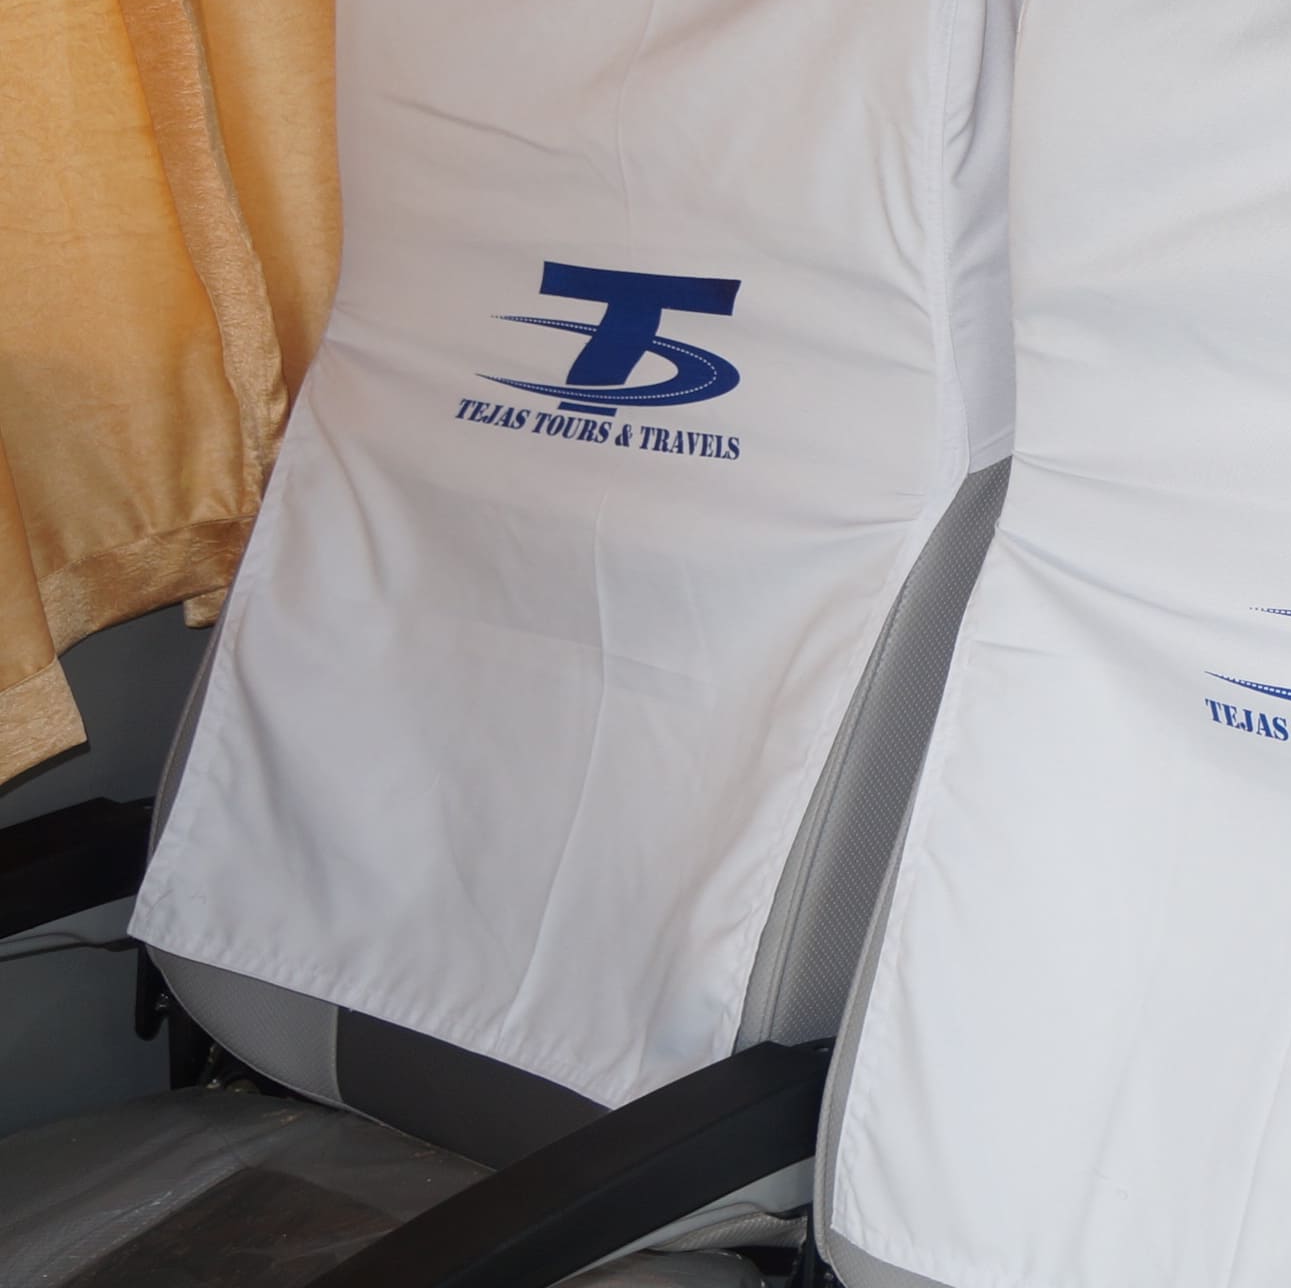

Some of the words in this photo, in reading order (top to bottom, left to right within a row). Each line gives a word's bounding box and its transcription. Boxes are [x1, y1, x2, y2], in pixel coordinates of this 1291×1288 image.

[455, 398, 531, 430] TEJAS
[531, 411, 613, 445] TOURS
[615, 423, 633, 448] &
[639, 425, 741, 461] TRAVELS
[1204, 698, 1289, 742] TEJAS
